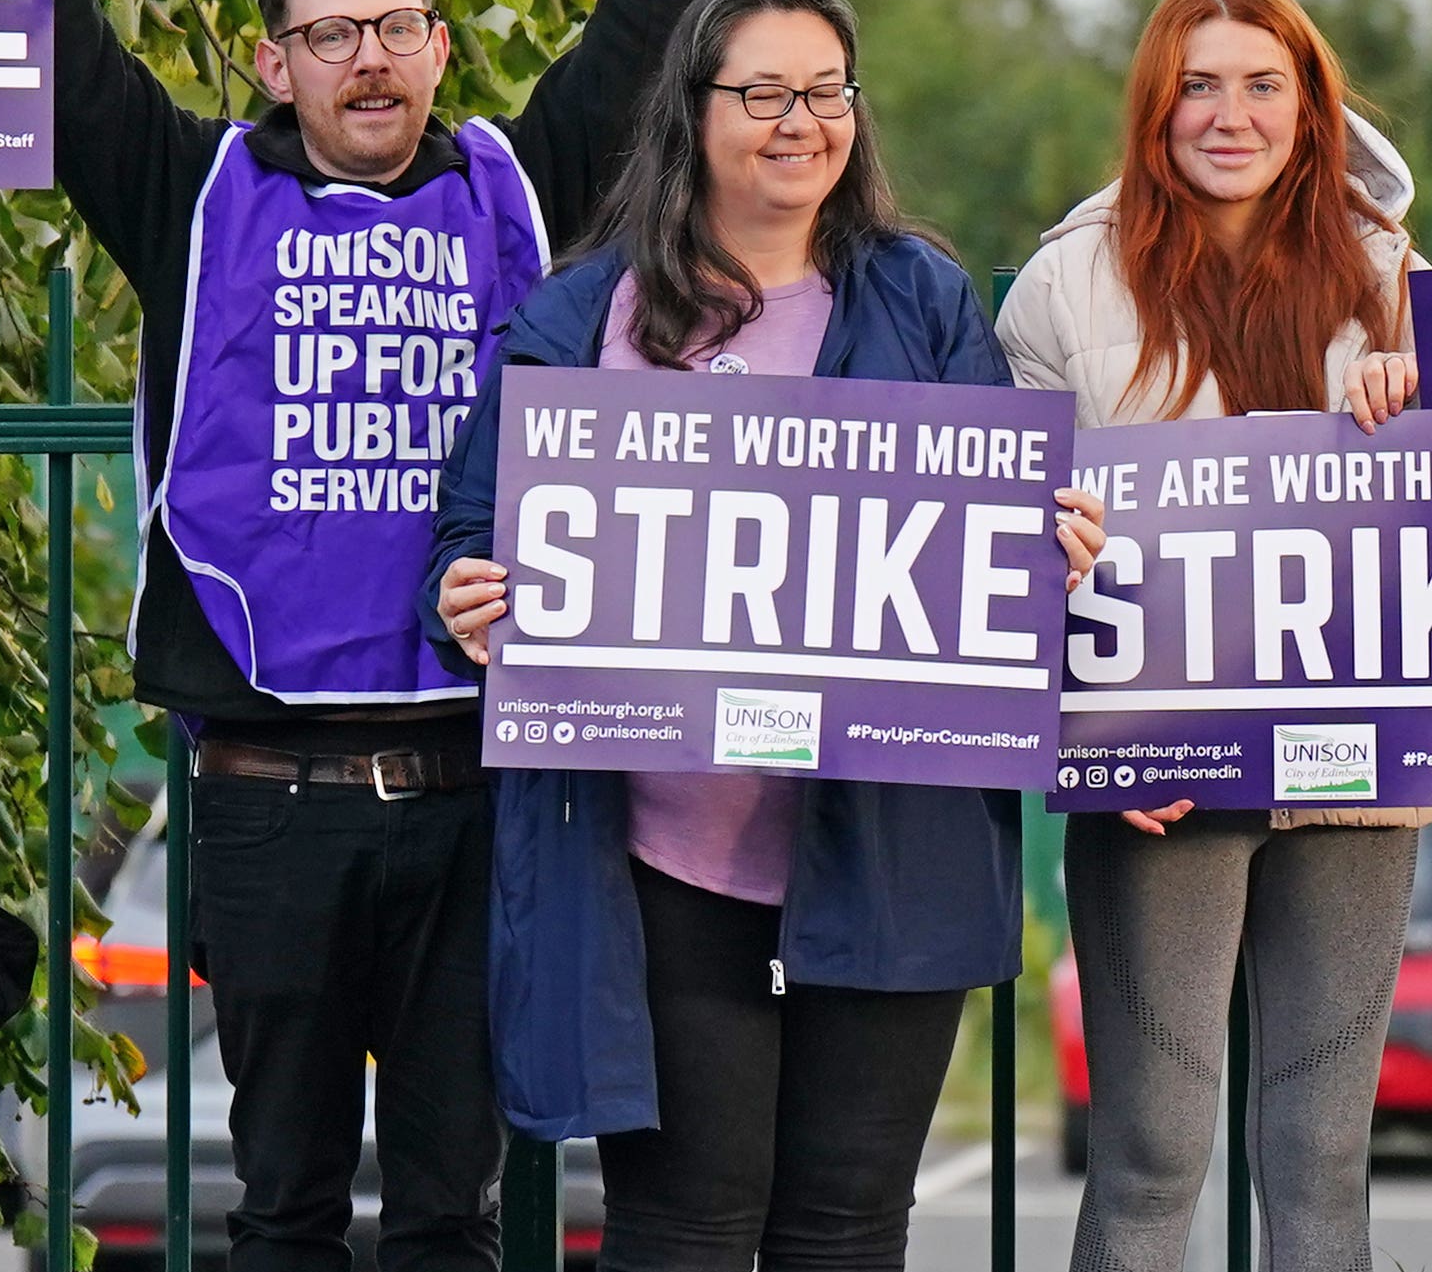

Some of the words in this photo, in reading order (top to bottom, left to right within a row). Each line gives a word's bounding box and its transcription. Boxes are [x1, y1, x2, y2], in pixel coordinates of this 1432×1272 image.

[277, 223, 468, 286] UNISON
[275, 285, 477, 332] SPEAKING
[275, 335, 357, 395] UP
[366, 334, 477, 397] FOR
[525, 408, 597, 458] WE
[616, 411, 711, 462] ARE
[733, 415, 896, 472] WORTH
[916, 425, 1047, 480] MORE
[1158, 457, 1249, 507] ARE
[1270, 452, 1431, 502] WORTH
[514, 484, 1044, 661] STRIKE
[498, 699, 683, 720] unison-edinburgh.org.uk
[726, 708, 811, 729] UNISON
[581, 723, 682, 743] @unisonedin
[726, 732, 745, 743] City
[749, 734, 762, 745] of
[763, 734, 816, 747] Edinburgh
[847, 724, 1039, 749] #PayUpForCouncilStaff
[1058, 742, 1242, 760] unison-edinburgh.org.uk
[1284, 744, 1367, 762] UNISON
[1143, 765, 1241, 783] @unisonedin
[1285, 768, 1306, 780] City
[1308, 768, 1320, 780] of
[1321, 767, 1374, 780] Edinburgh
